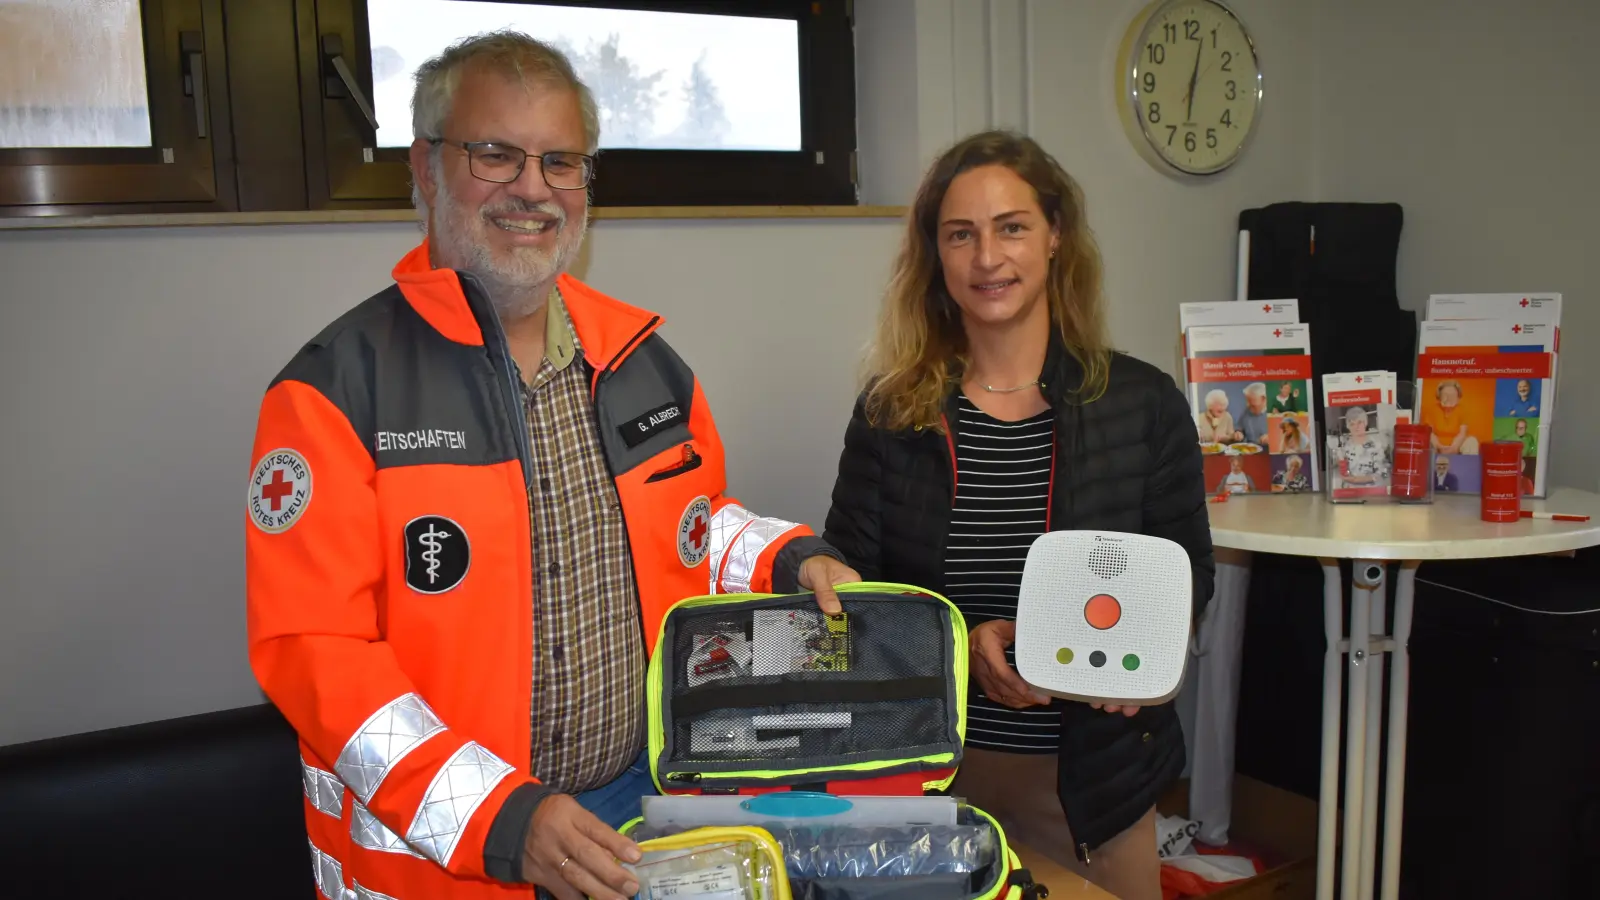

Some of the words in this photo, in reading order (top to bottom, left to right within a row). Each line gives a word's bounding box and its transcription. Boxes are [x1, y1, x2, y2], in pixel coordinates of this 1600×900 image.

[1163, 23, 1176, 44] 11
[1183, 19, 1200, 41] 12
[1210, 29, 1217, 48] 1
[1147, 44, 1165, 64] 10
[1221, 51, 1232, 72] 2
[1143, 72, 1155, 93] 9
[1225, 80, 1236, 101] 3
[1148, 102, 1160, 123] 8
[1220, 109, 1231, 128] 4
[1165, 125, 1177, 145] 7
[1184, 132, 1196, 152] 6
[1206, 128, 1217, 148] 5
[638, 422, 649, 432] G.
[255, 454, 305, 486] DEUTSCHES
[252, 495, 274, 527] ROTES
[277, 489, 306, 527] KREUZ
[681, 541, 697, 562] ROTES
